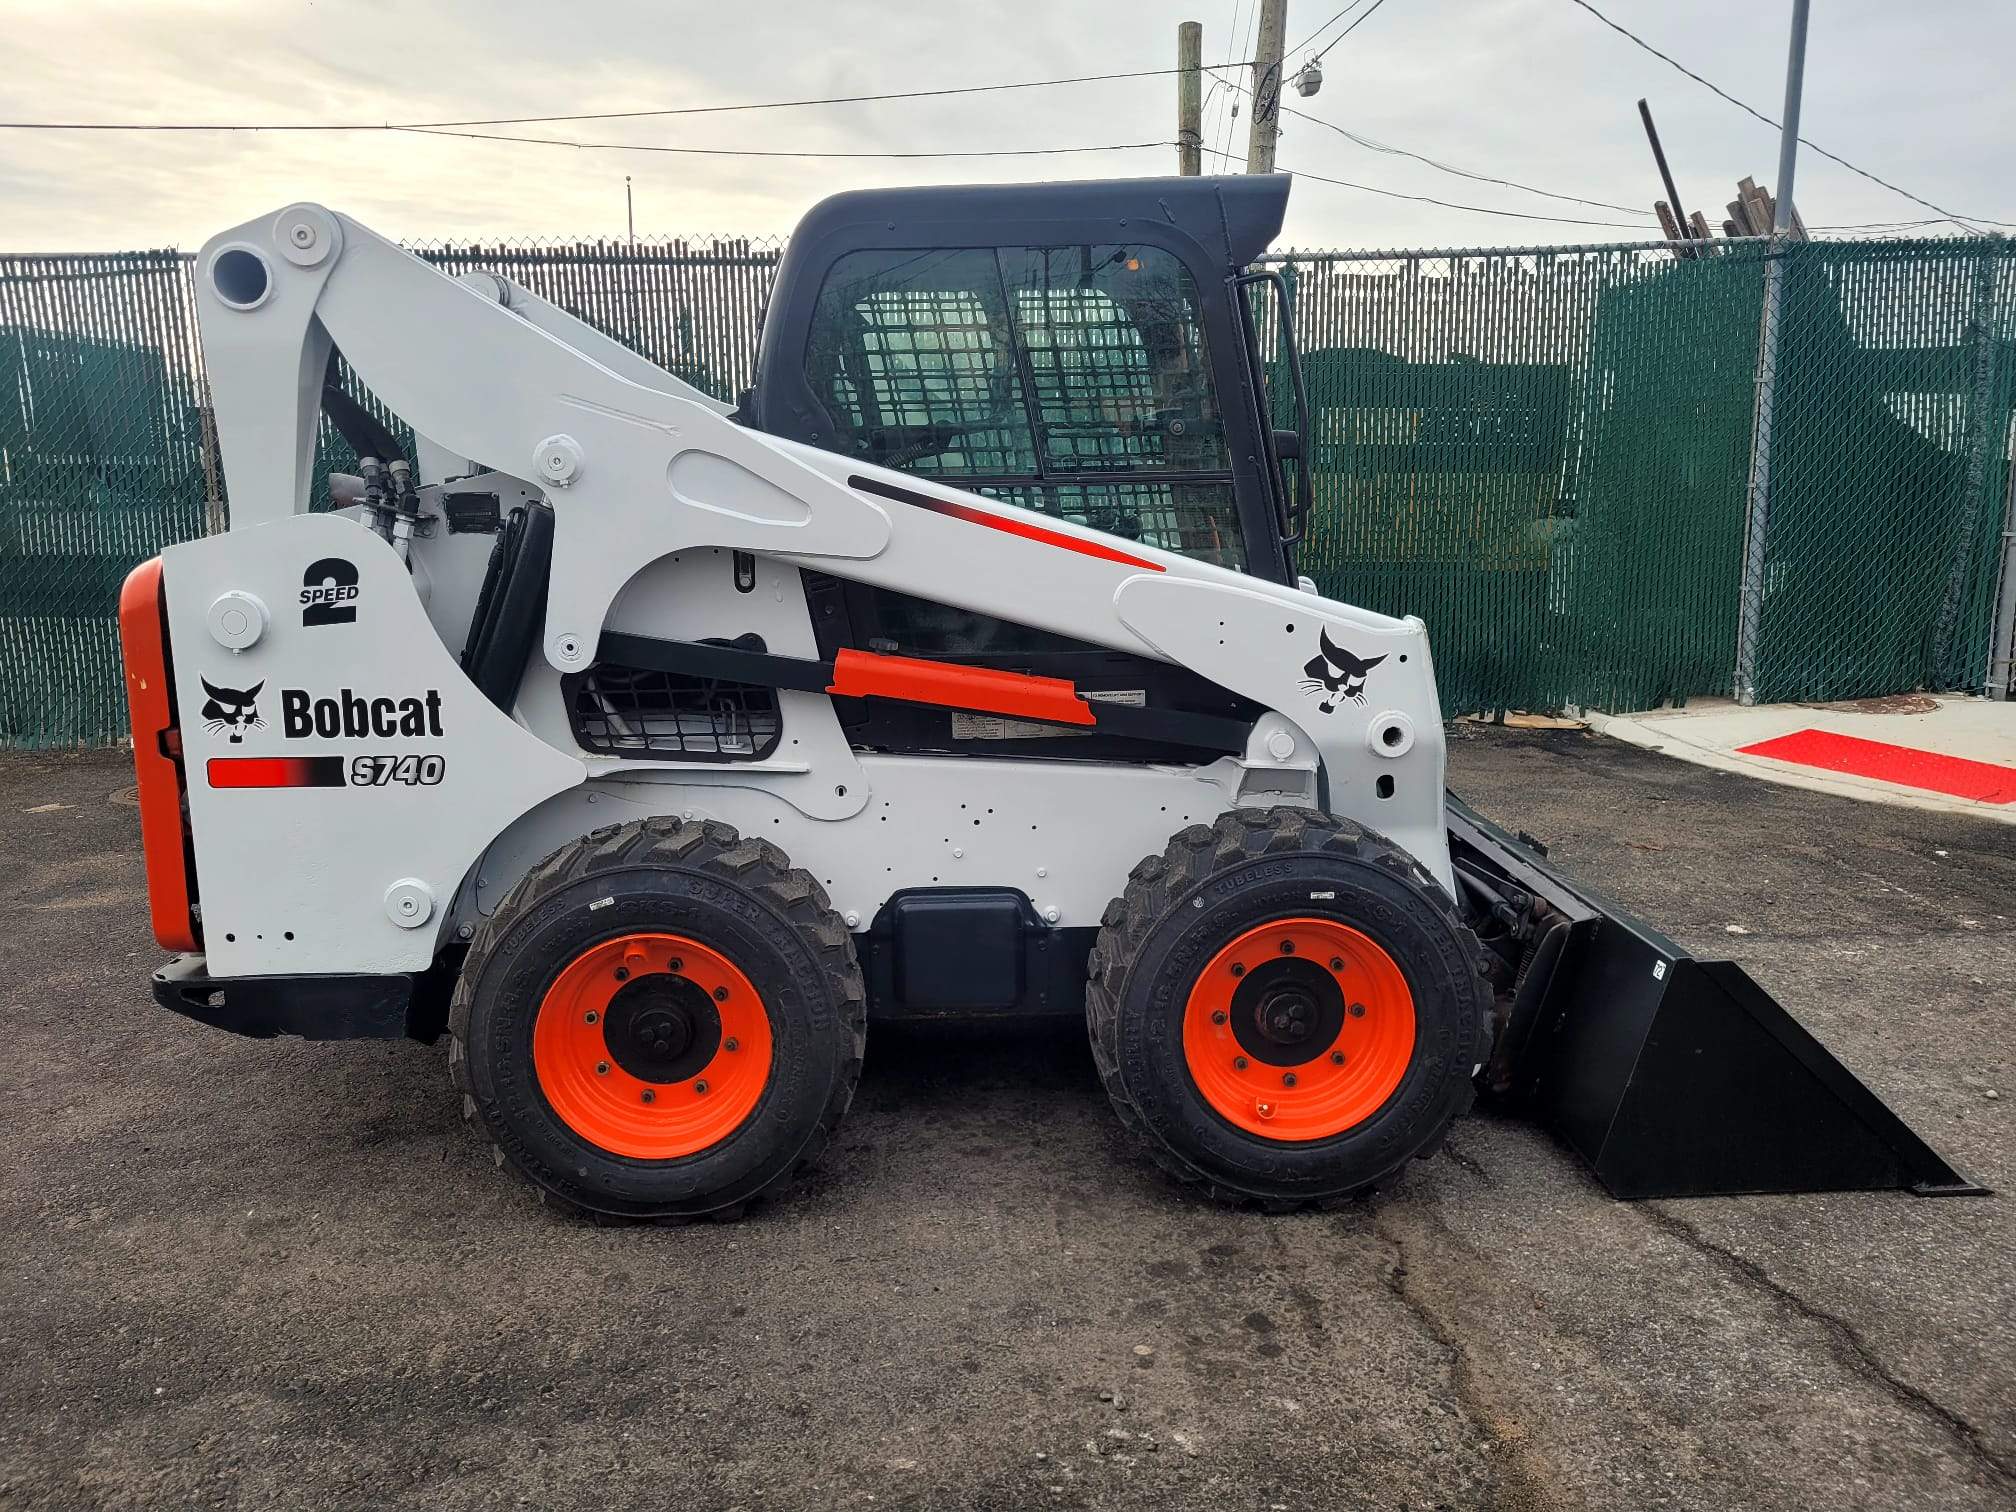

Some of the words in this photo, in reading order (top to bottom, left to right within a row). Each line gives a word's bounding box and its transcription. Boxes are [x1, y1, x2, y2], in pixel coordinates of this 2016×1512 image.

[299, 586, 359, 604] SPEED
[281, 688, 444, 738] Bobcat
[351, 755, 446, 786] S740
[1216, 863, 1293, 894] TUBELESS
